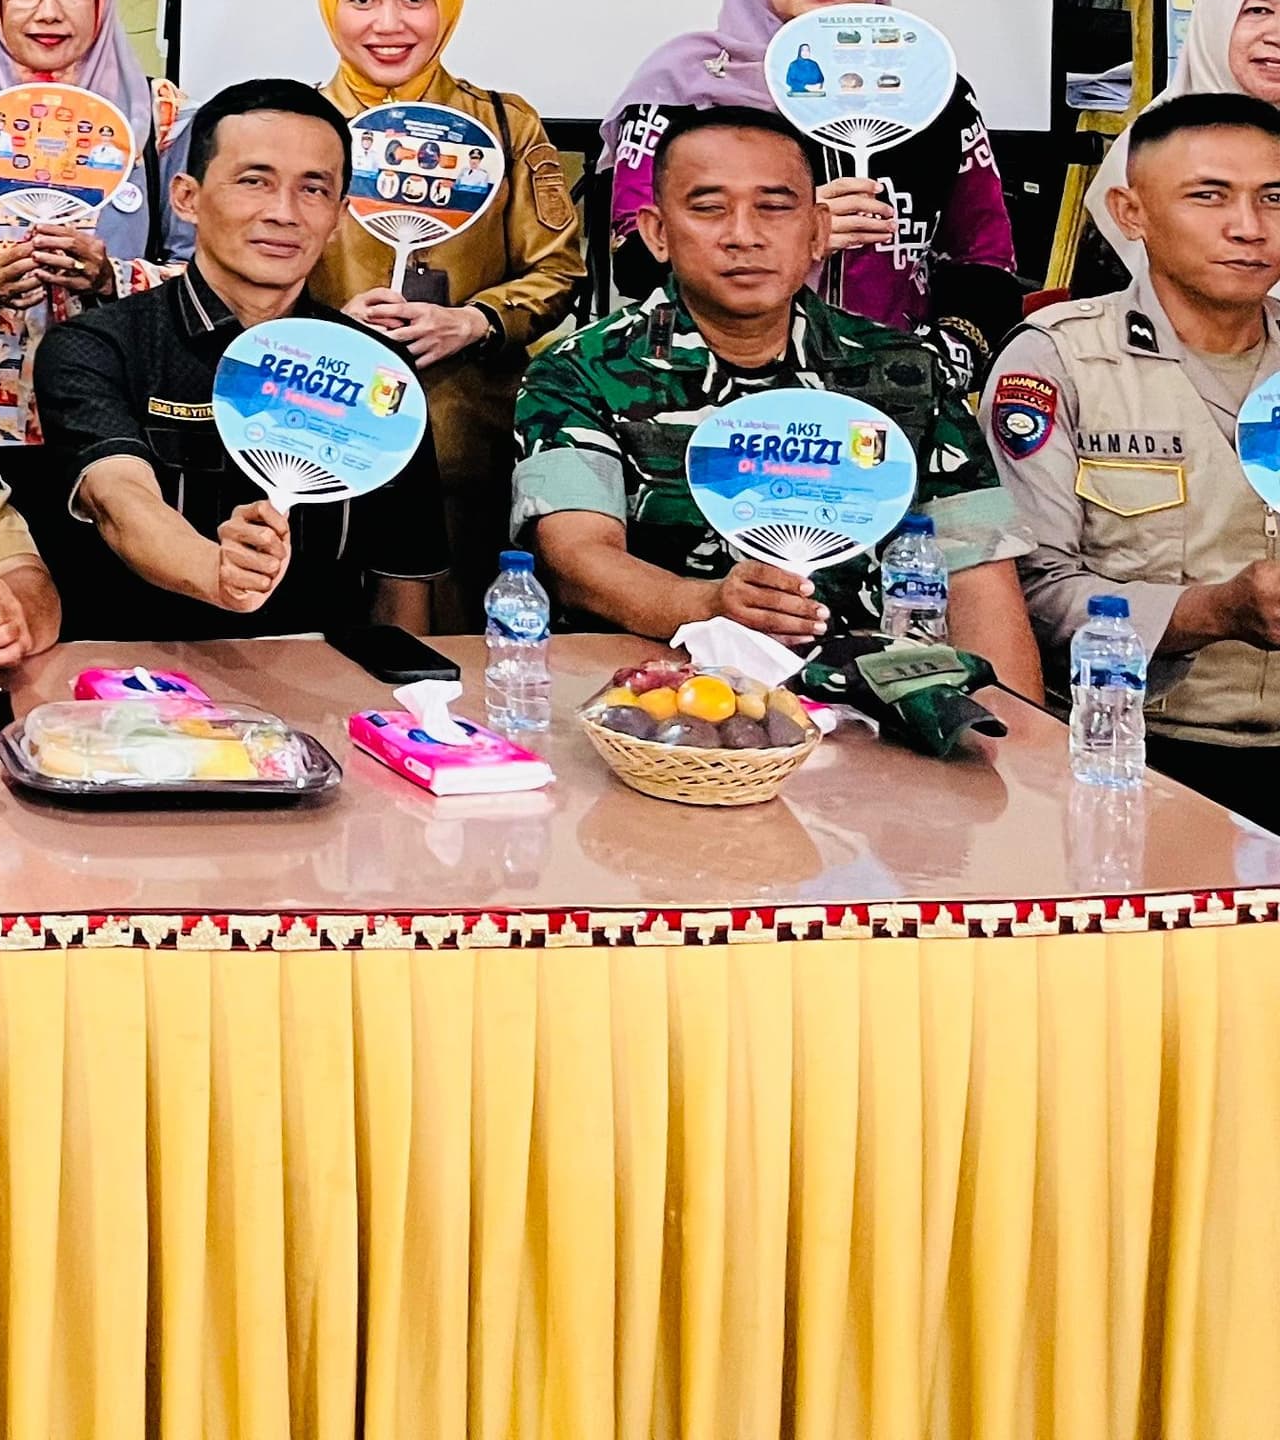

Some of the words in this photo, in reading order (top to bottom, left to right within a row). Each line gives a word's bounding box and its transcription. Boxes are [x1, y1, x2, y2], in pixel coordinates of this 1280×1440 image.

[316, 355, 350, 376] AKSI
[260, 354, 365, 407] BERGIZI
[786, 422, 822, 437] AKSI
[729, 433, 843, 465] BERGIZI
